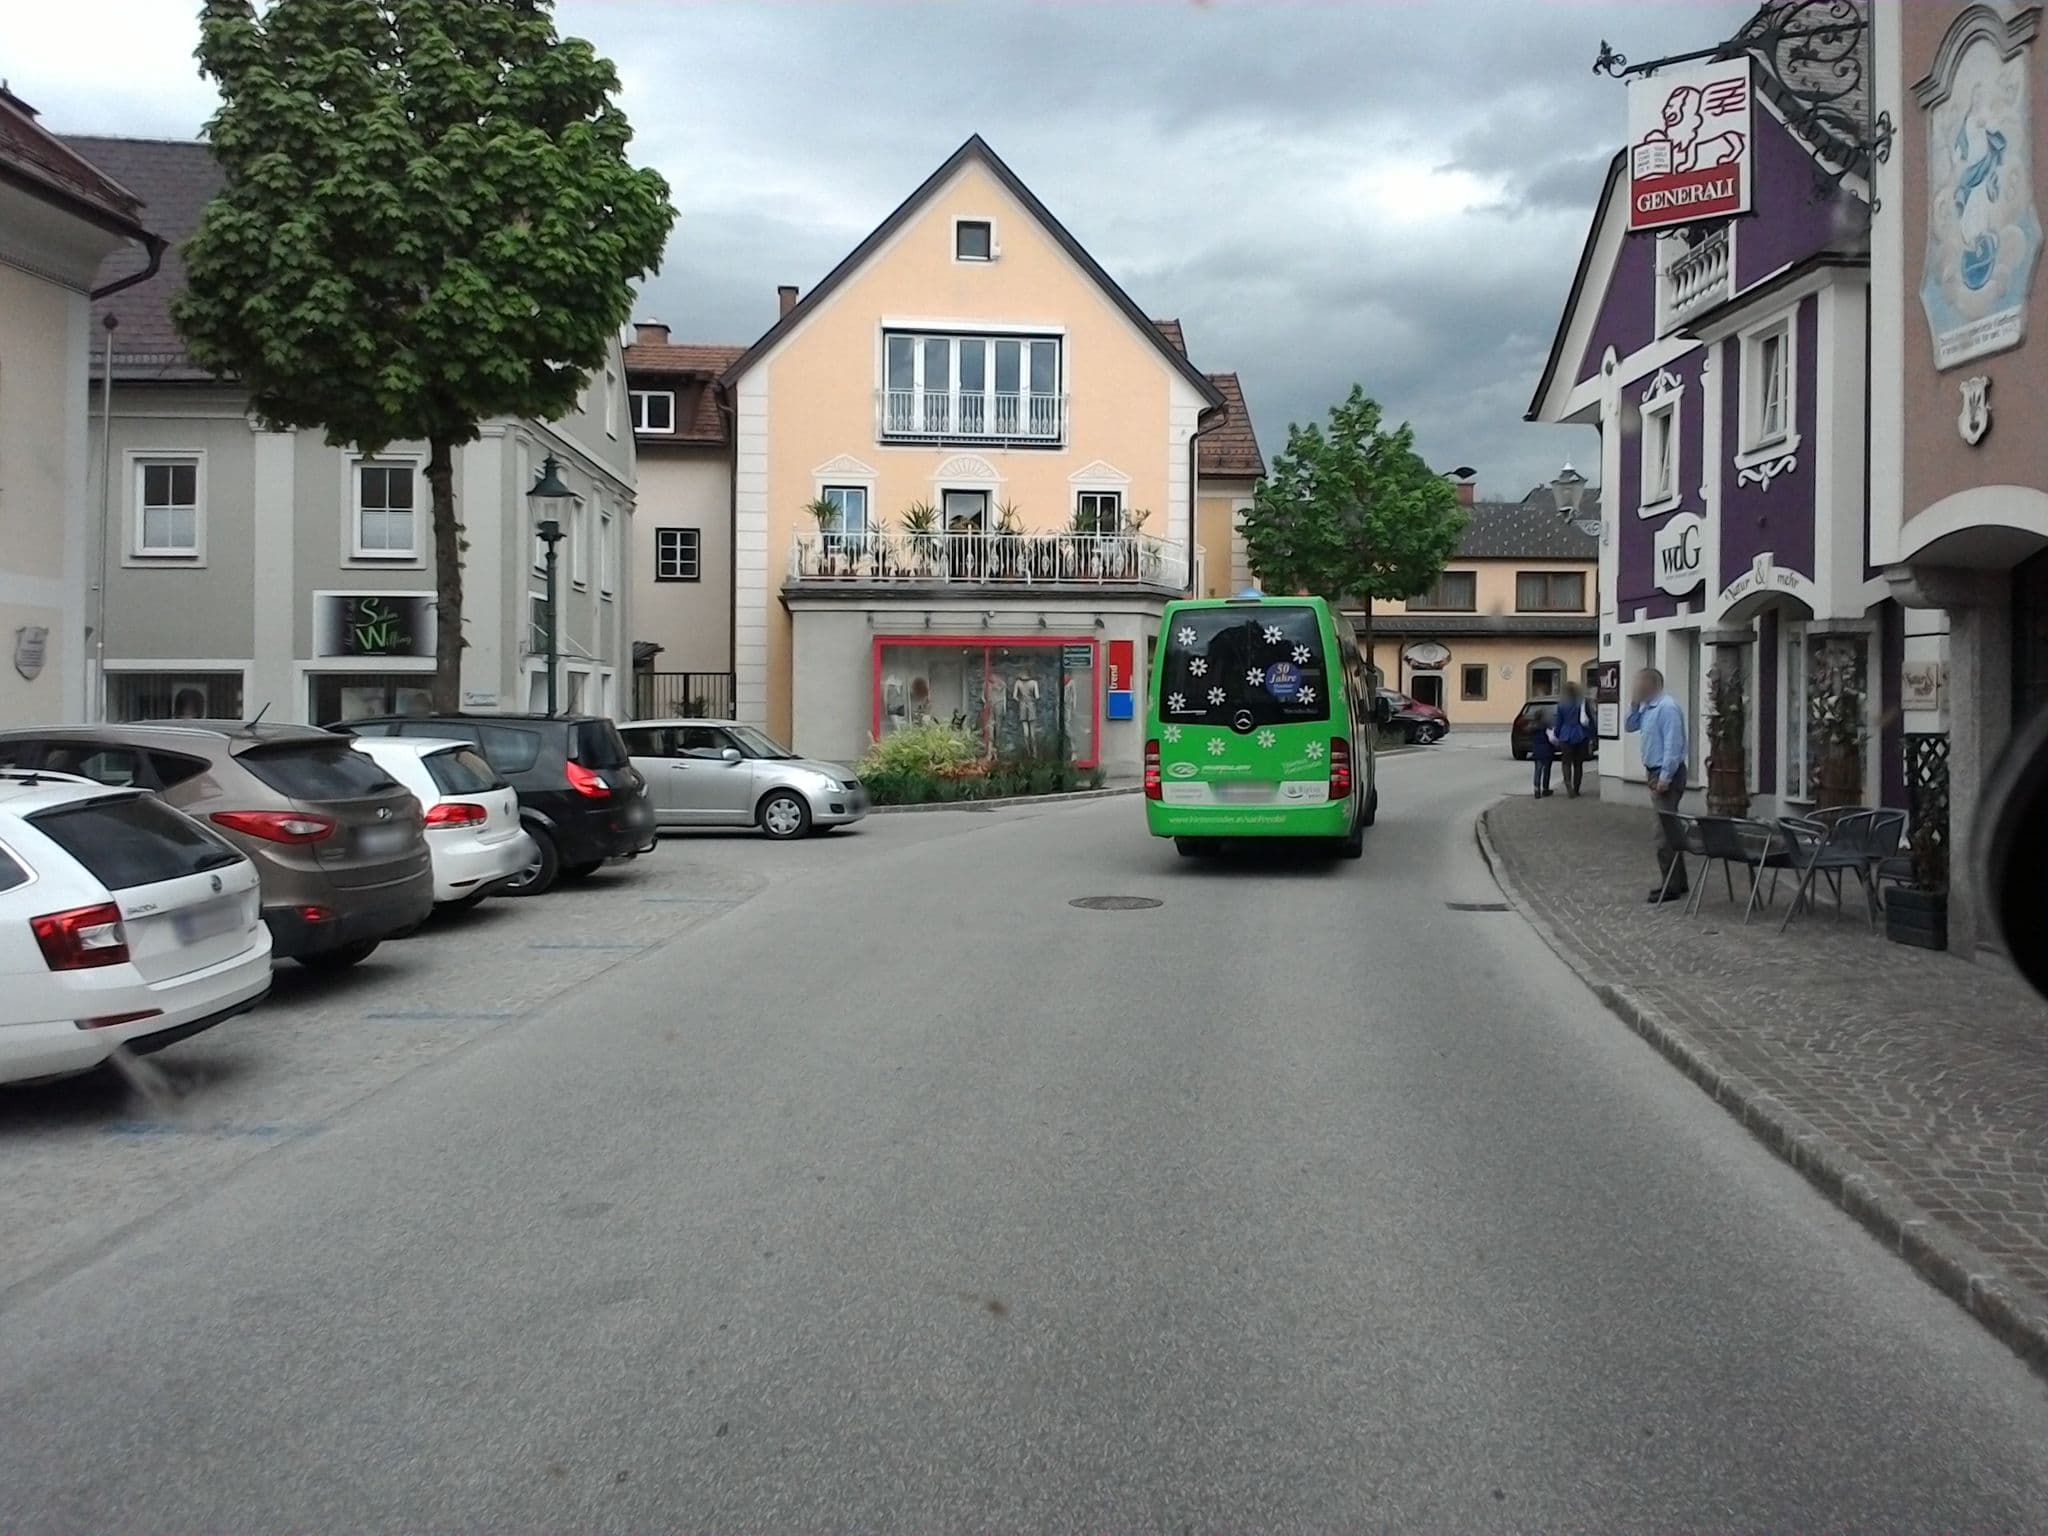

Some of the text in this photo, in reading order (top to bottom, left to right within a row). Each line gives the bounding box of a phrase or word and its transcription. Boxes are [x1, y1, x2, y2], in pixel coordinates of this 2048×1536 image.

[1637, 178, 1735, 212] GENERALI
[1662, 525, 1702, 574] wdG
[1754, 561, 1766, 585] &
[1776, 571, 1800, 588] mehr
[1109, 664, 1118, 690] trend
[1269, 673, 1297, 683] Jahre
[1276, 663, 1290, 674] 50
